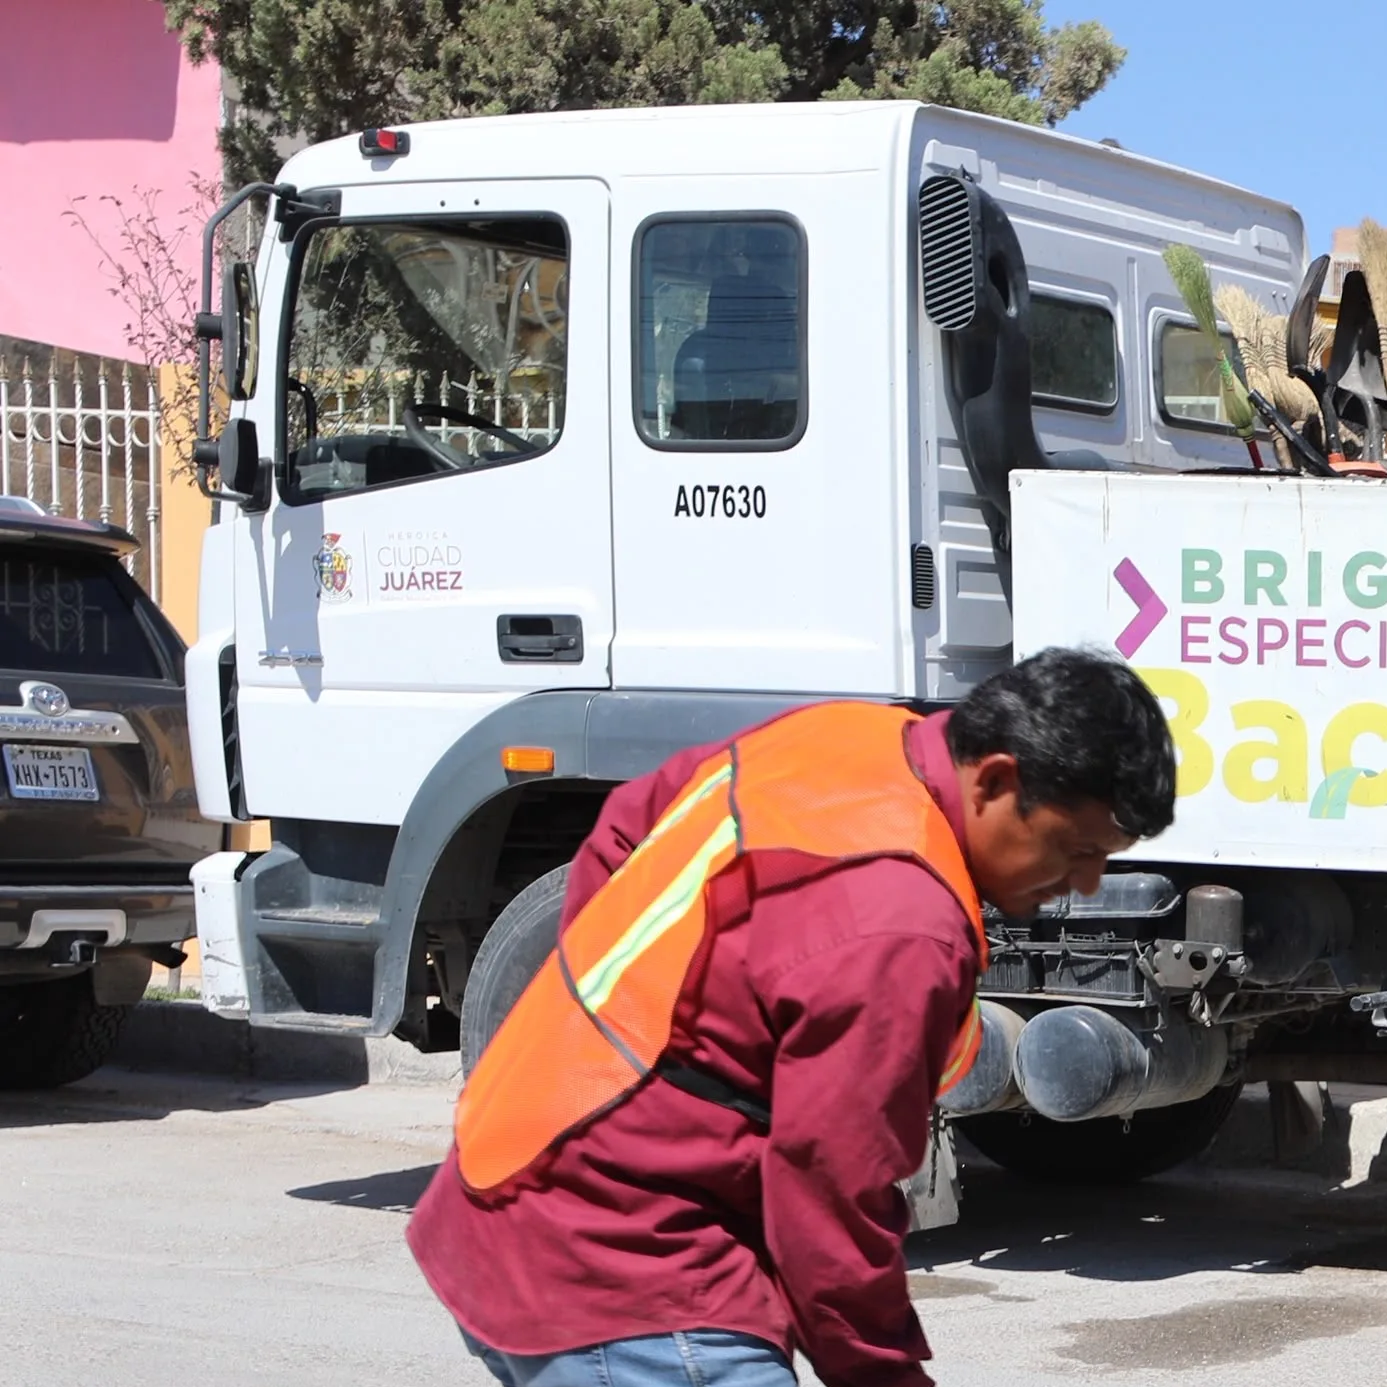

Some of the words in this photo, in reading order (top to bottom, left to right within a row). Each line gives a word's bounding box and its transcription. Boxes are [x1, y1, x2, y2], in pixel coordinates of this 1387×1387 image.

[674, 484, 766, 518] A07630
[378, 546, 462, 567] CIUDAD
[379, 566, 463, 591] JUÁREZ
[31, 750, 63, 760] TEXAS
